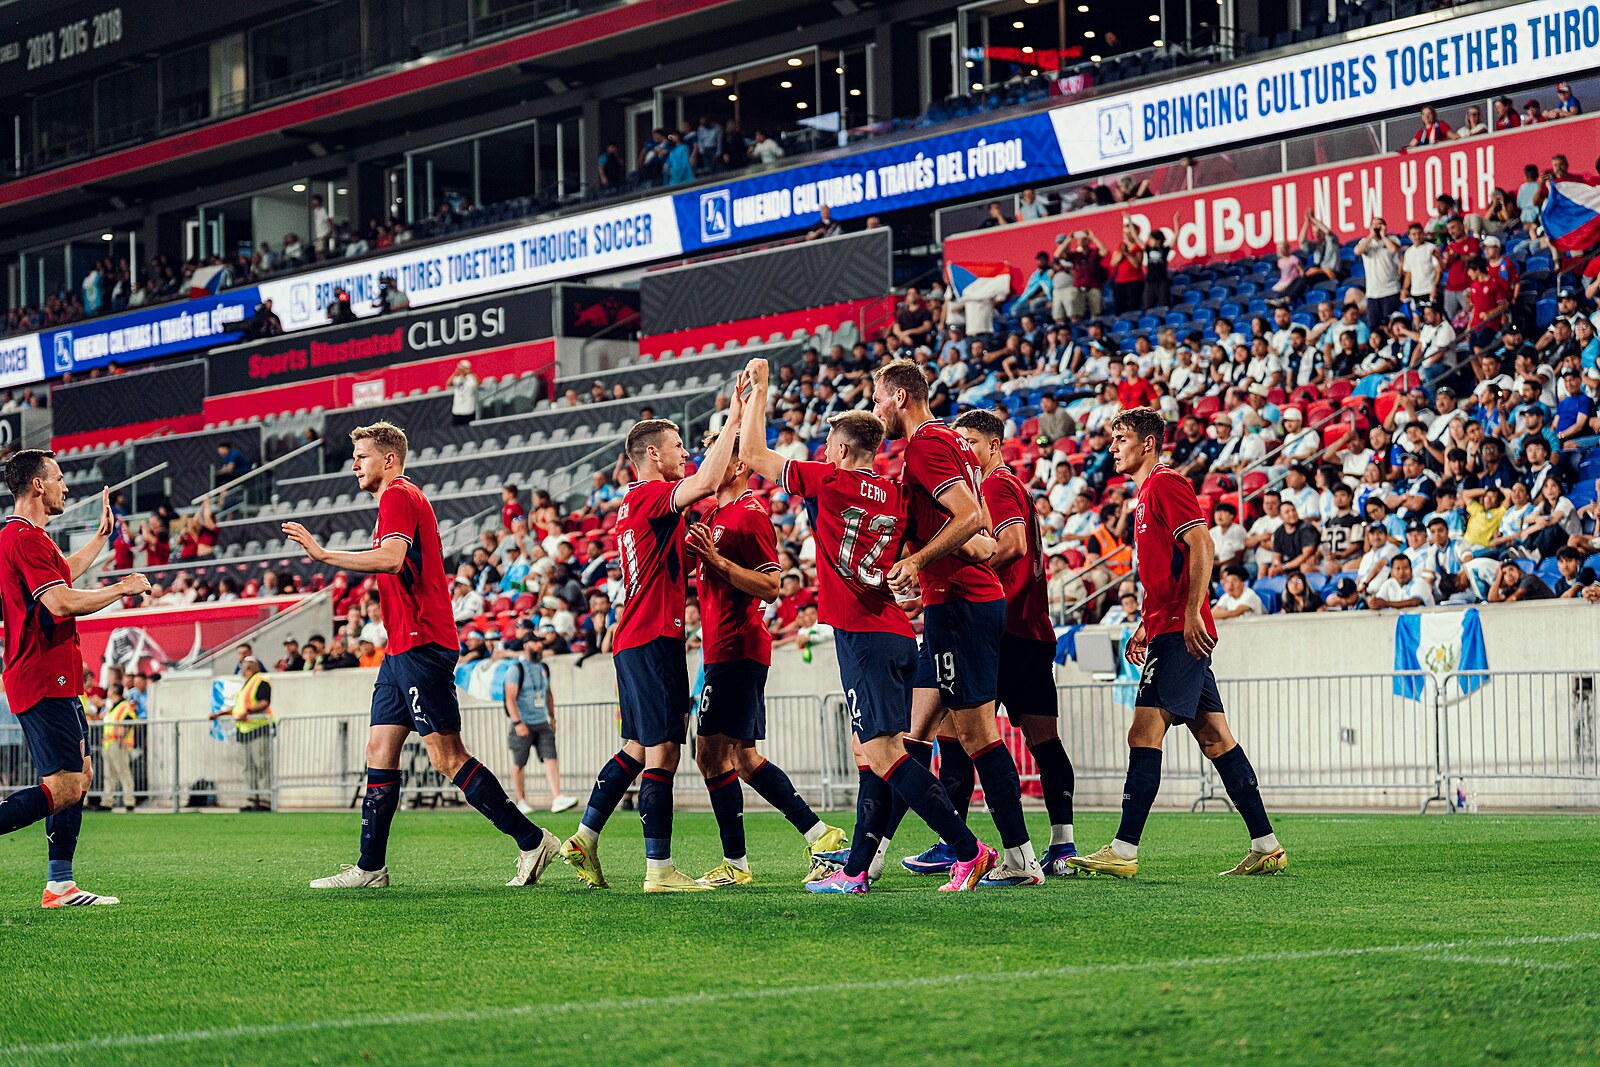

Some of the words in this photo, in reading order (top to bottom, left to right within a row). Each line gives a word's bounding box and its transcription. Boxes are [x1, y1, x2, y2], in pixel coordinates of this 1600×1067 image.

[27, 31, 55, 71] 2013
[59, 19, 88, 59] 2015
[1143, 83, 1248, 141] BRINGING
[1257, 54, 1377, 117] CULTURES
[1386, 22, 1518, 90] TOGETHER
[1527, 5, 1600, 60] THRO
[733, 188, 791, 228] UNIENDO
[793, 172, 864, 215] CULTURAS
[865, 170, 878, 200] A
[878, 152, 935, 198] TRAVÉS
[936, 150, 966, 186] DEL
[967, 138, 1027, 180] FÚTBOL
[1212, 182, 1298, 254] Bull
[1313, 166, 1383, 233] NEW
[1399, 145, 1496, 222] YORK
[447, 242, 515, 285] TOGETHER
[521, 226, 588, 270] THROUGH
[593, 213, 653, 255] SOCCER
[248, 349, 308, 378] Sports
[310, 327, 404, 367] Illustrated
[407, 312, 478, 351] CLUB
[481, 306, 505, 338] SI
[839, 505, 898, 590] 12
[408, 686, 422, 714] 2
[934, 651, 955, 683] 19
